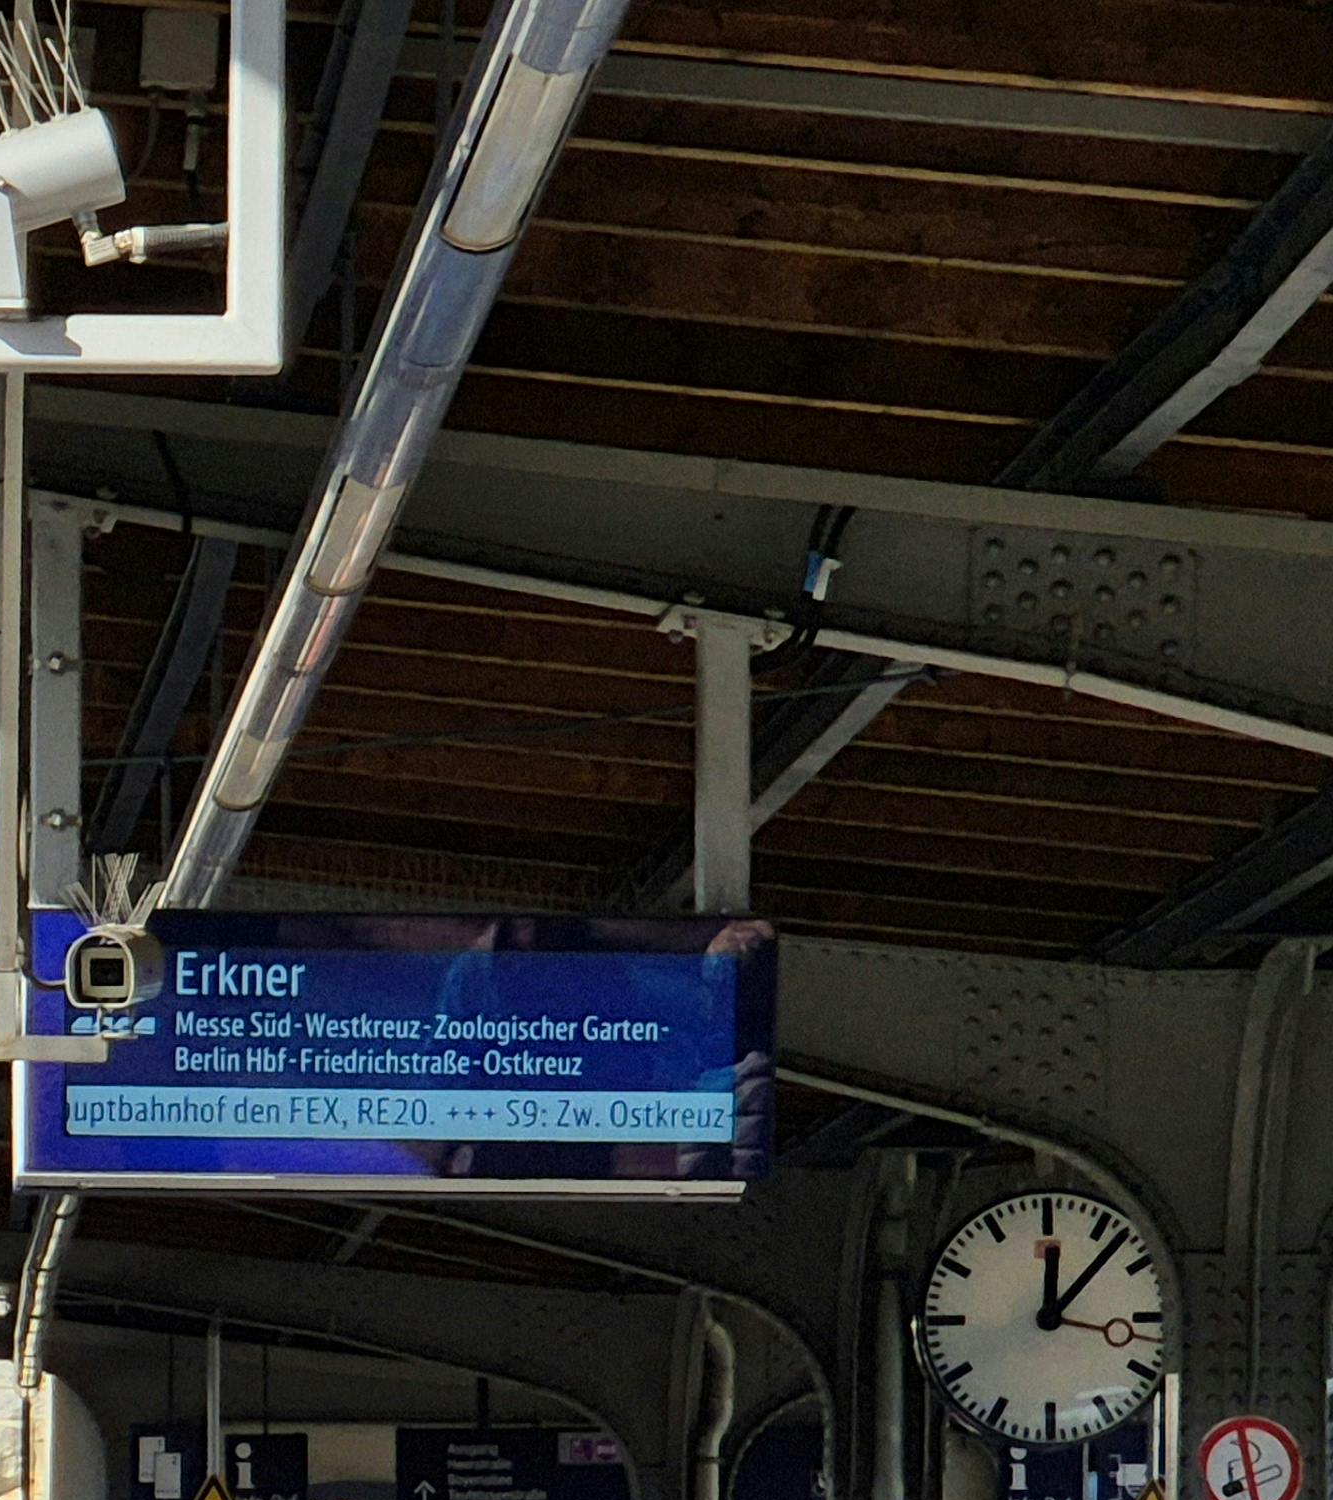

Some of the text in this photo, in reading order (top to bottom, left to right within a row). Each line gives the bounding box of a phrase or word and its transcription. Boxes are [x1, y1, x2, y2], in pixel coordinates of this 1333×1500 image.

[175, 951, 306, 998] Erkner
[175, 1010, 244, 1037] Messe
[175, 1047, 240, 1072] Berlin
[67, 1094, 225, 1128] uptbahnhof
[234, 1096, 280, 1124] den
[289, 1096, 348, 1130] FEX,
[358, 1097, 435, 1125] RE20.
[506, 1098, 547, 1127] S9:
[557, 1099, 600, 1127] Zw.
